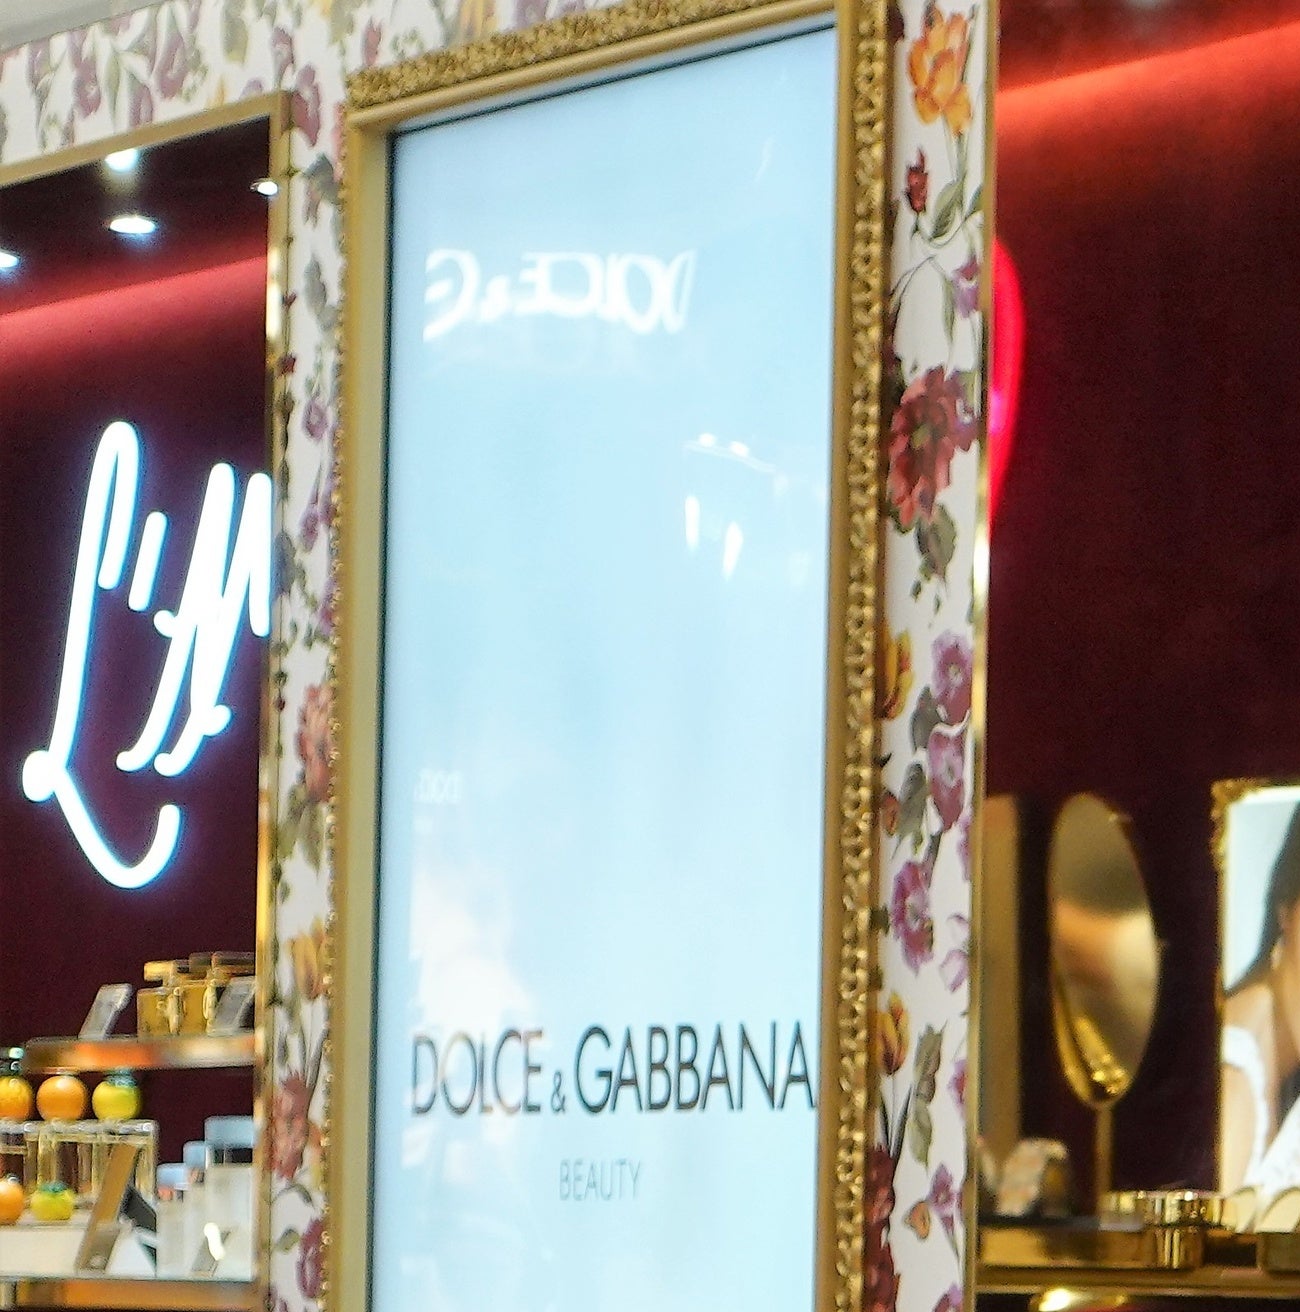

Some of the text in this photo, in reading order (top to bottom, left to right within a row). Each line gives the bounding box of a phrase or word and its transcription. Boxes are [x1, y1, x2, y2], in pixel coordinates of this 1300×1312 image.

[411, 1020, 818, 1116] DOLCE & GABBANA
[559, 1158, 645, 1202] BEAUTY
